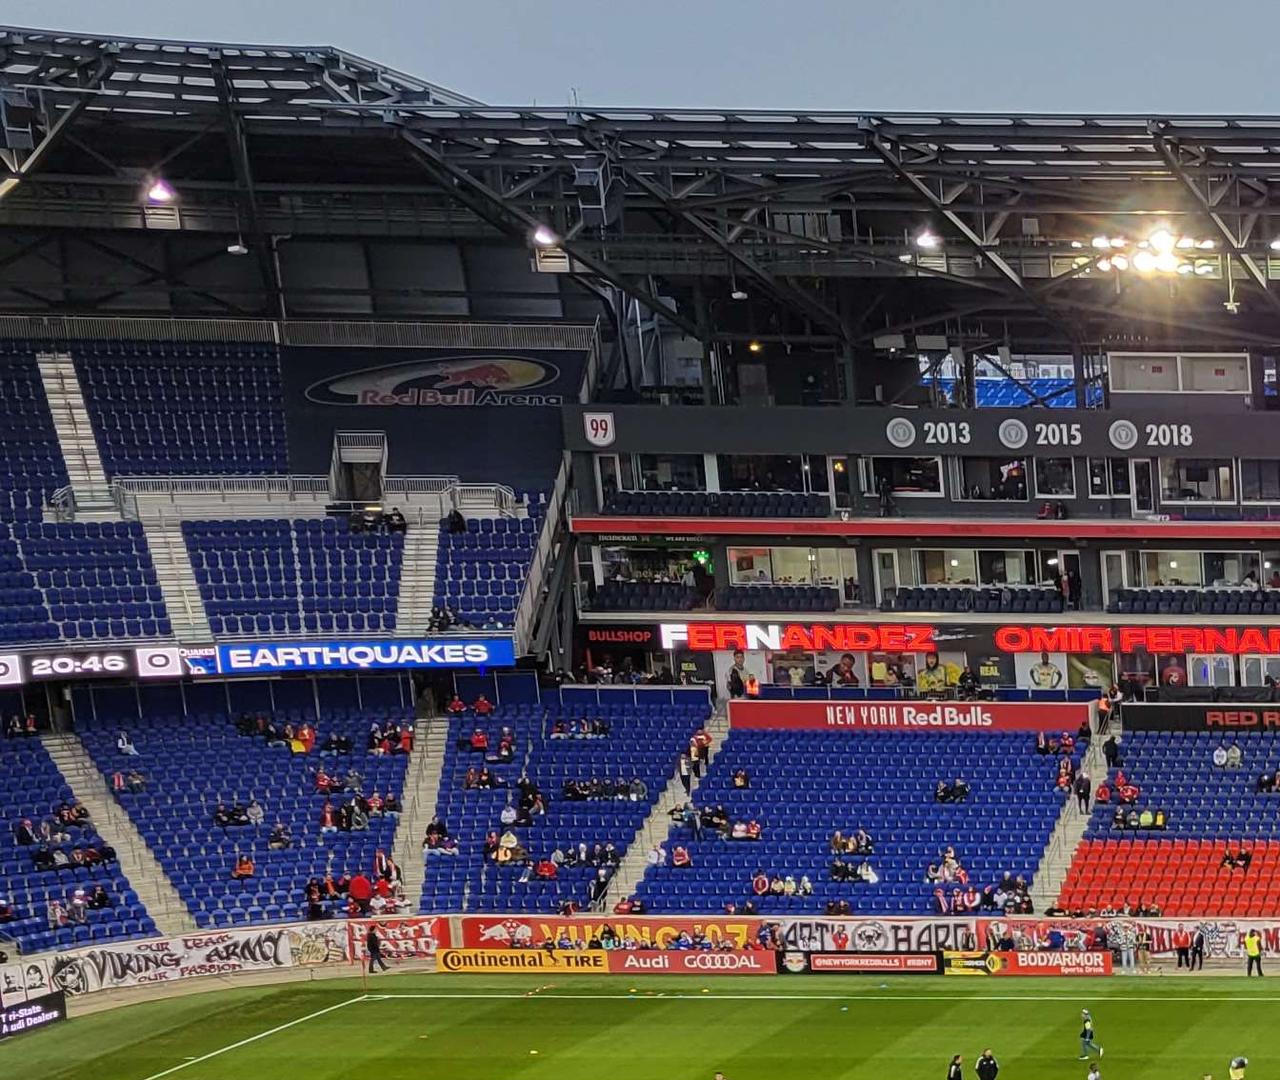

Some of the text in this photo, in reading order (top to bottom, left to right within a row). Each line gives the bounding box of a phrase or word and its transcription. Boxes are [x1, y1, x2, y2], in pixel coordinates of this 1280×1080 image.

[475, 392, 563, 406] Arena
[590, 419, 609, 438] 99
[923, 422, 971, 444] 2013
[1035, 423, 1082, 446] 2015
[1145, 424, 1192, 446] 2018
[588, 630, 652, 642] BULLSHOP
[660, 623, 937, 650] FERNANDEZ
[994, 626, 1113, 653] OMIR
[31, 655, 127, 675] 20:46
[230, 644, 489, 668] EARTHQUAKES
[826, 706, 856, 725] NEW
[860, 706, 897, 725] YORK
[1206, 711, 1258, 726] RED
[86, 949, 182, 987] VIKING
[205, 929, 293, 966] ARMY
[442, 950, 603, 970] Continental TIRE
[624, 953, 669, 968] Audi
[1017, 952, 1104, 966] BODYARMOR
